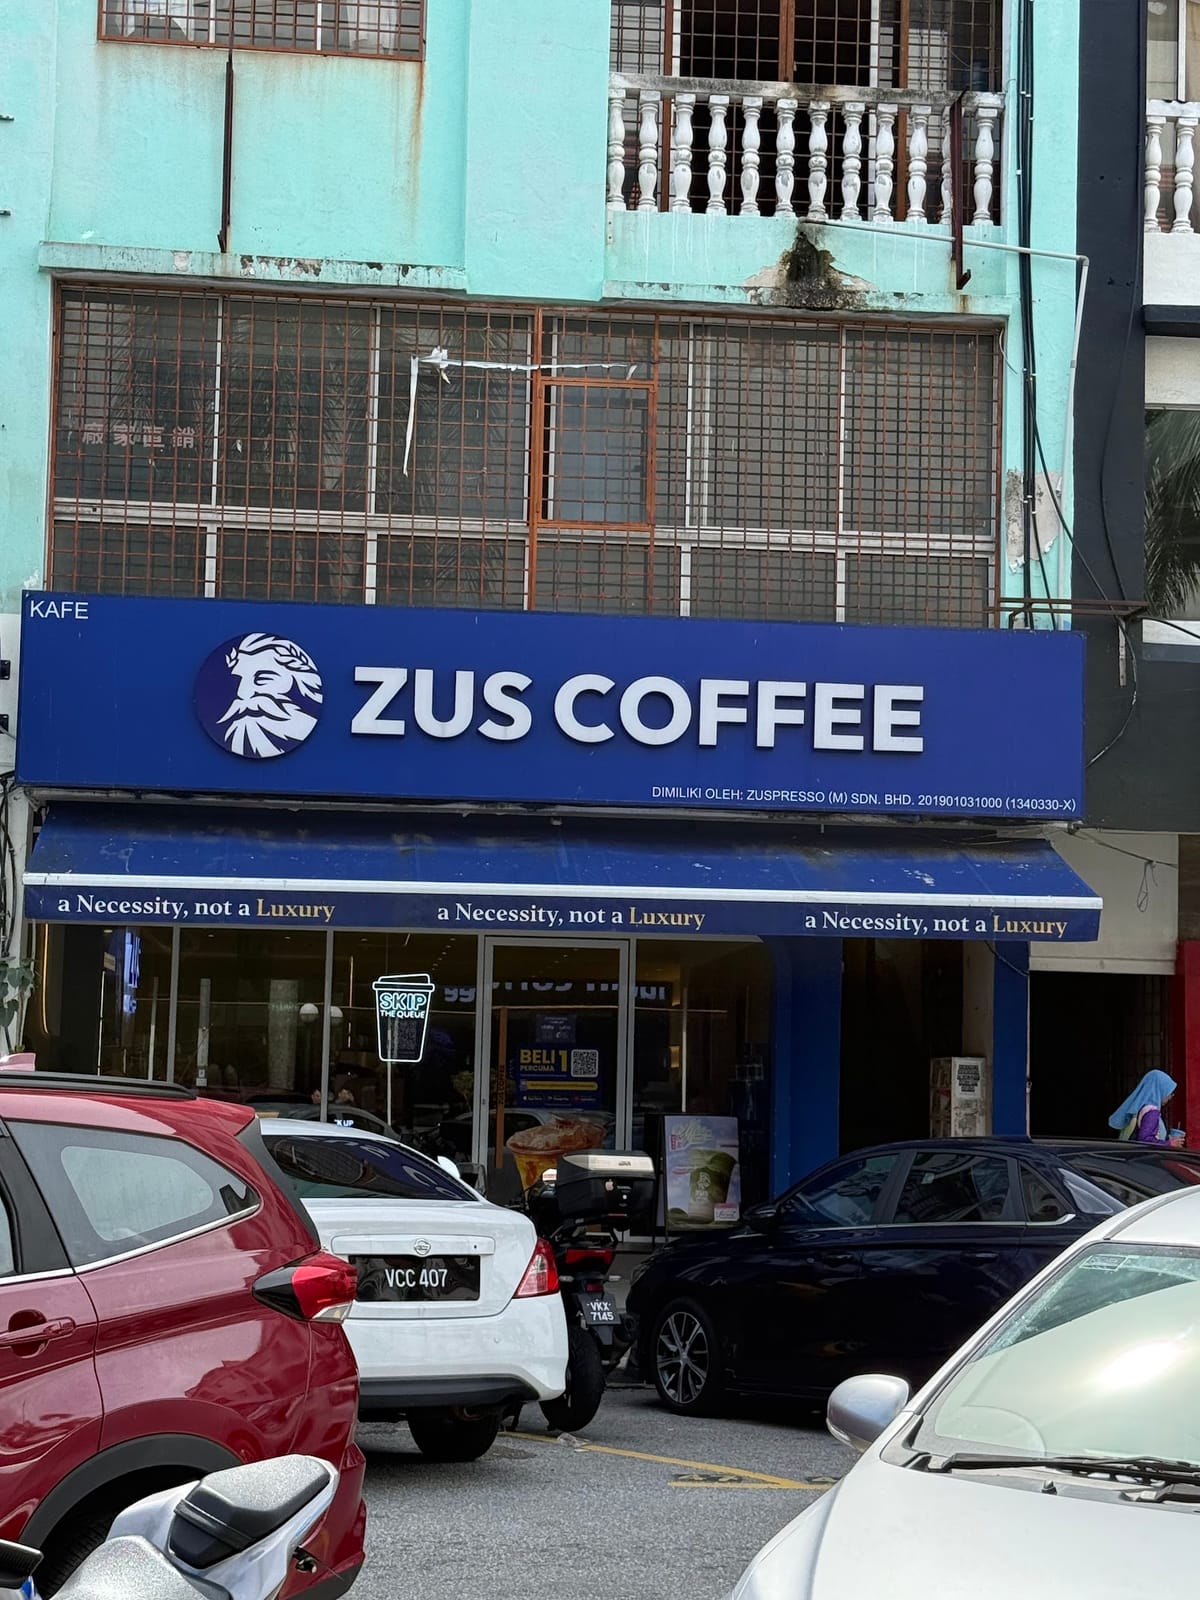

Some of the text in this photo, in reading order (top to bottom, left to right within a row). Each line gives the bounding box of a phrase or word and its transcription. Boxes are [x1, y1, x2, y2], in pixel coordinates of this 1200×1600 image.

[28, 600, 89, 620] KAFE
[351, 666, 924, 754] ZUS COFFEE
[652, 786, 1076, 813] DIMILIKI OLEH: ZUSPRESSO (M) SDN. BHD. 201901031000 (1340330-X)
[58, 895, 336, 923] a Necessity, not a Luxury
[437, 903, 705, 931] a Necessity, not a Luxury
[805, 911, 1068, 938] a Necessity, not a Luxury
[379, 992, 427, 1011] SKIP
[380, 1010, 426, 1019] THE QUEUE
[519, 1049, 568, 1072] BELI 1
[519, 1064, 555, 1072] PERCUMA
[384, 1268, 448, 1288] VCC 407
[589, 1301, 610, 1311] VKX
[590, 1311, 614, 1321] 7145
